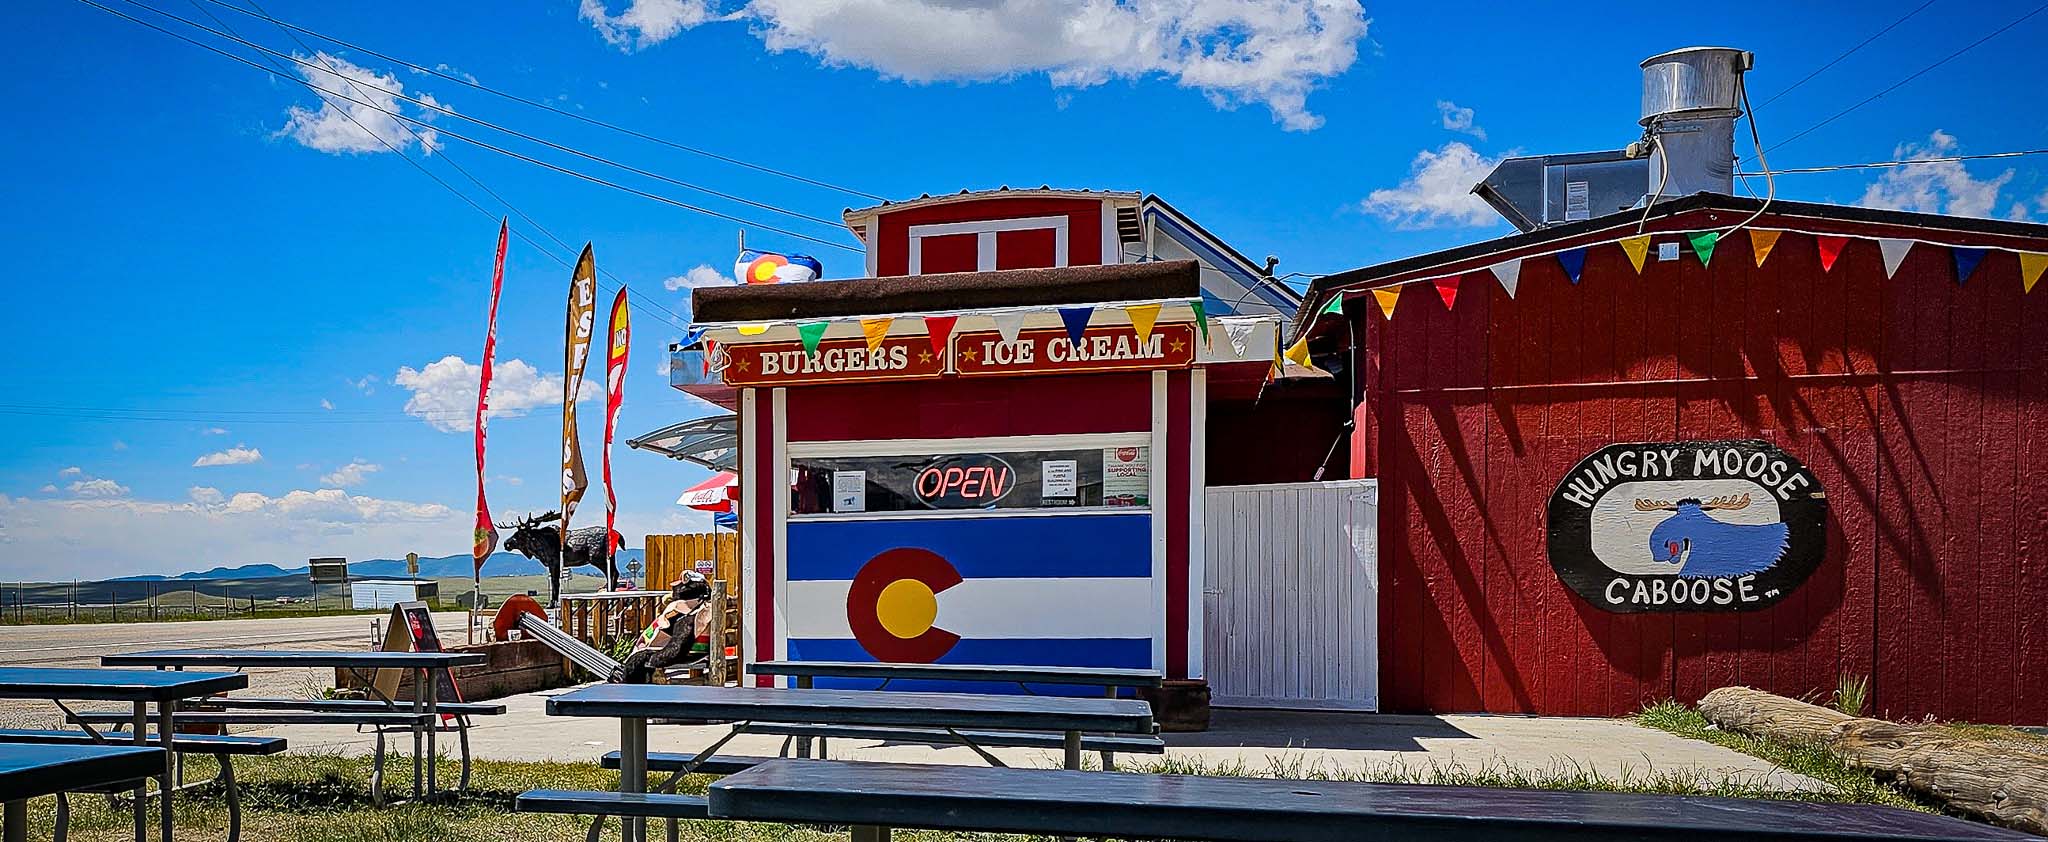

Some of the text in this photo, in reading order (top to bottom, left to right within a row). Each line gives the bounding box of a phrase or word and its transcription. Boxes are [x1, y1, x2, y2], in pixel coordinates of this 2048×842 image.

[759, 345, 909, 375] BURGERS
[981, 333, 1165, 366] ICE CREAM
[918, 466, 1008, 498] OPEN
[1562, 448, 1810, 508] HUNGRY MOOSE
[1604, 574, 1760, 605] CABOOSE
